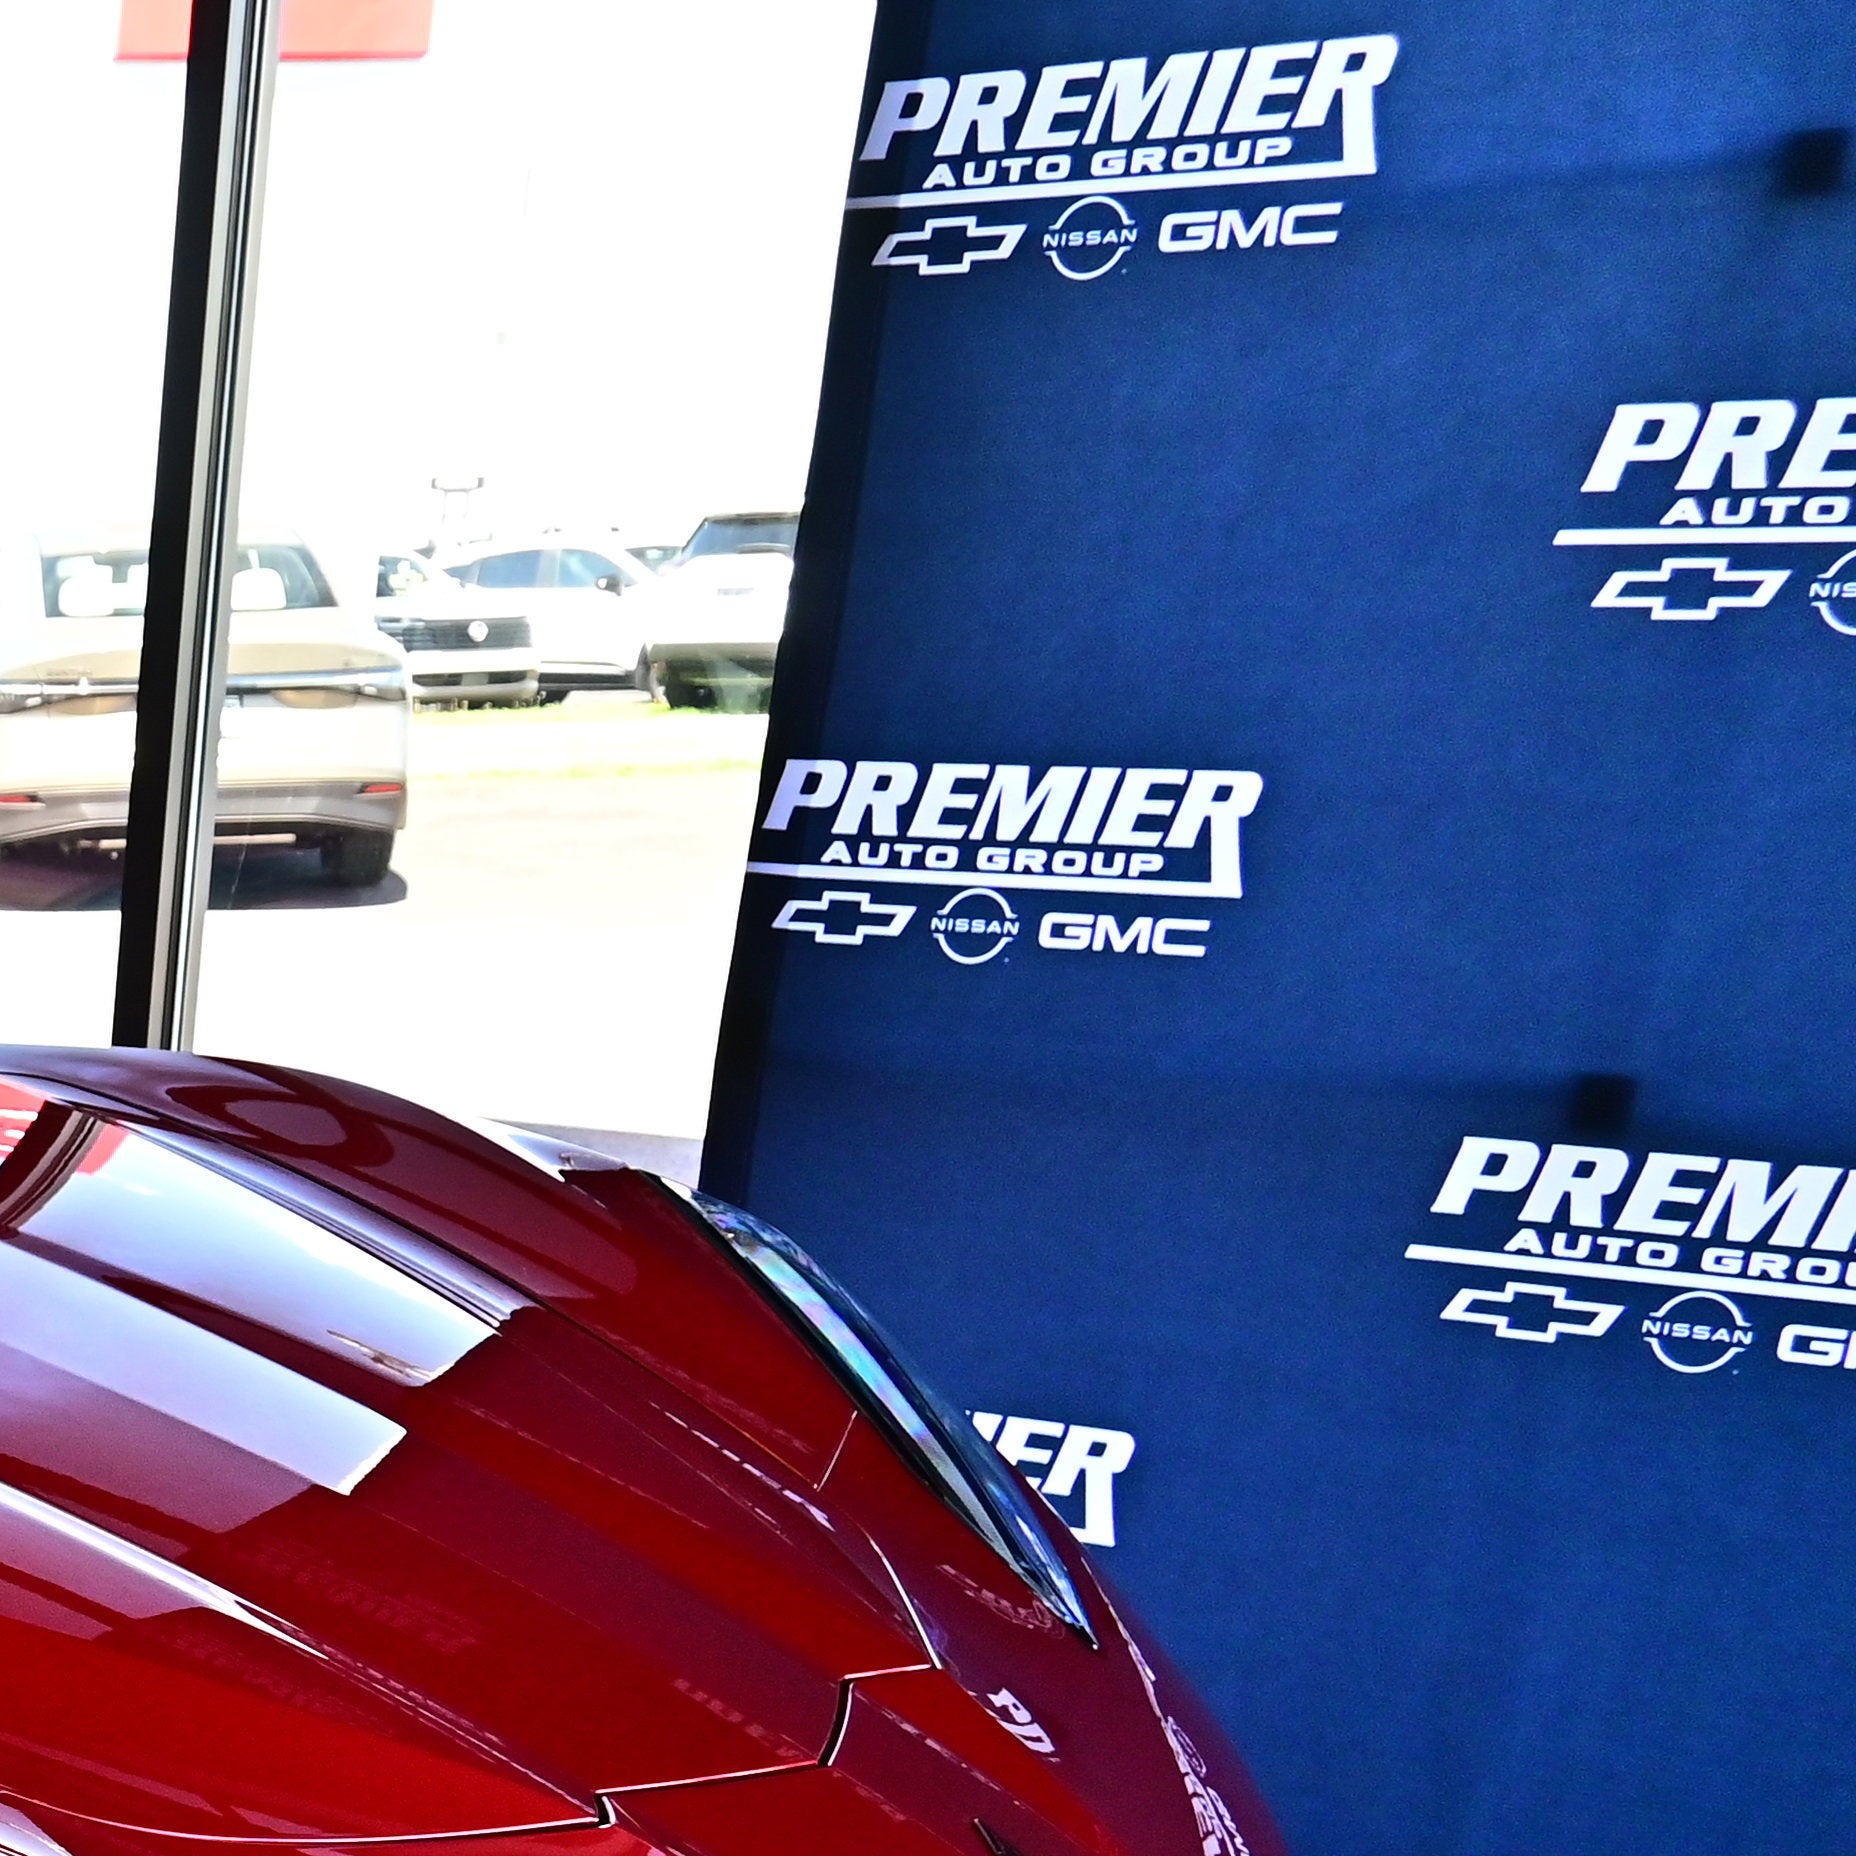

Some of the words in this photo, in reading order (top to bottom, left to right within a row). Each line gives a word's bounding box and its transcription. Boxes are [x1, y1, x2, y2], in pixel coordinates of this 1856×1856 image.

[860, 34, 1399, 174] PREMIER
[923, 154, 1071, 189] AUTO
[1090, 137, 1292, 176] GROUP
[1043, 227, 1137, 248] NISSAN
[1158, 202, 1343, 253] GMC
[1659, 496, 1851, 525] AUTO
[762, 759, 1263, 898] PREMIER
[821, 840, 958, 870] AUTO
[976, 847, 1165, 877] GROUP
[931, 917, 1019, 935] NISSAN
[1039, 911, 1210, 956] GMC
[1504, 1228, 1680, 1267] AUTO
[1641, 1318, 1754, 1345] NISSAN
